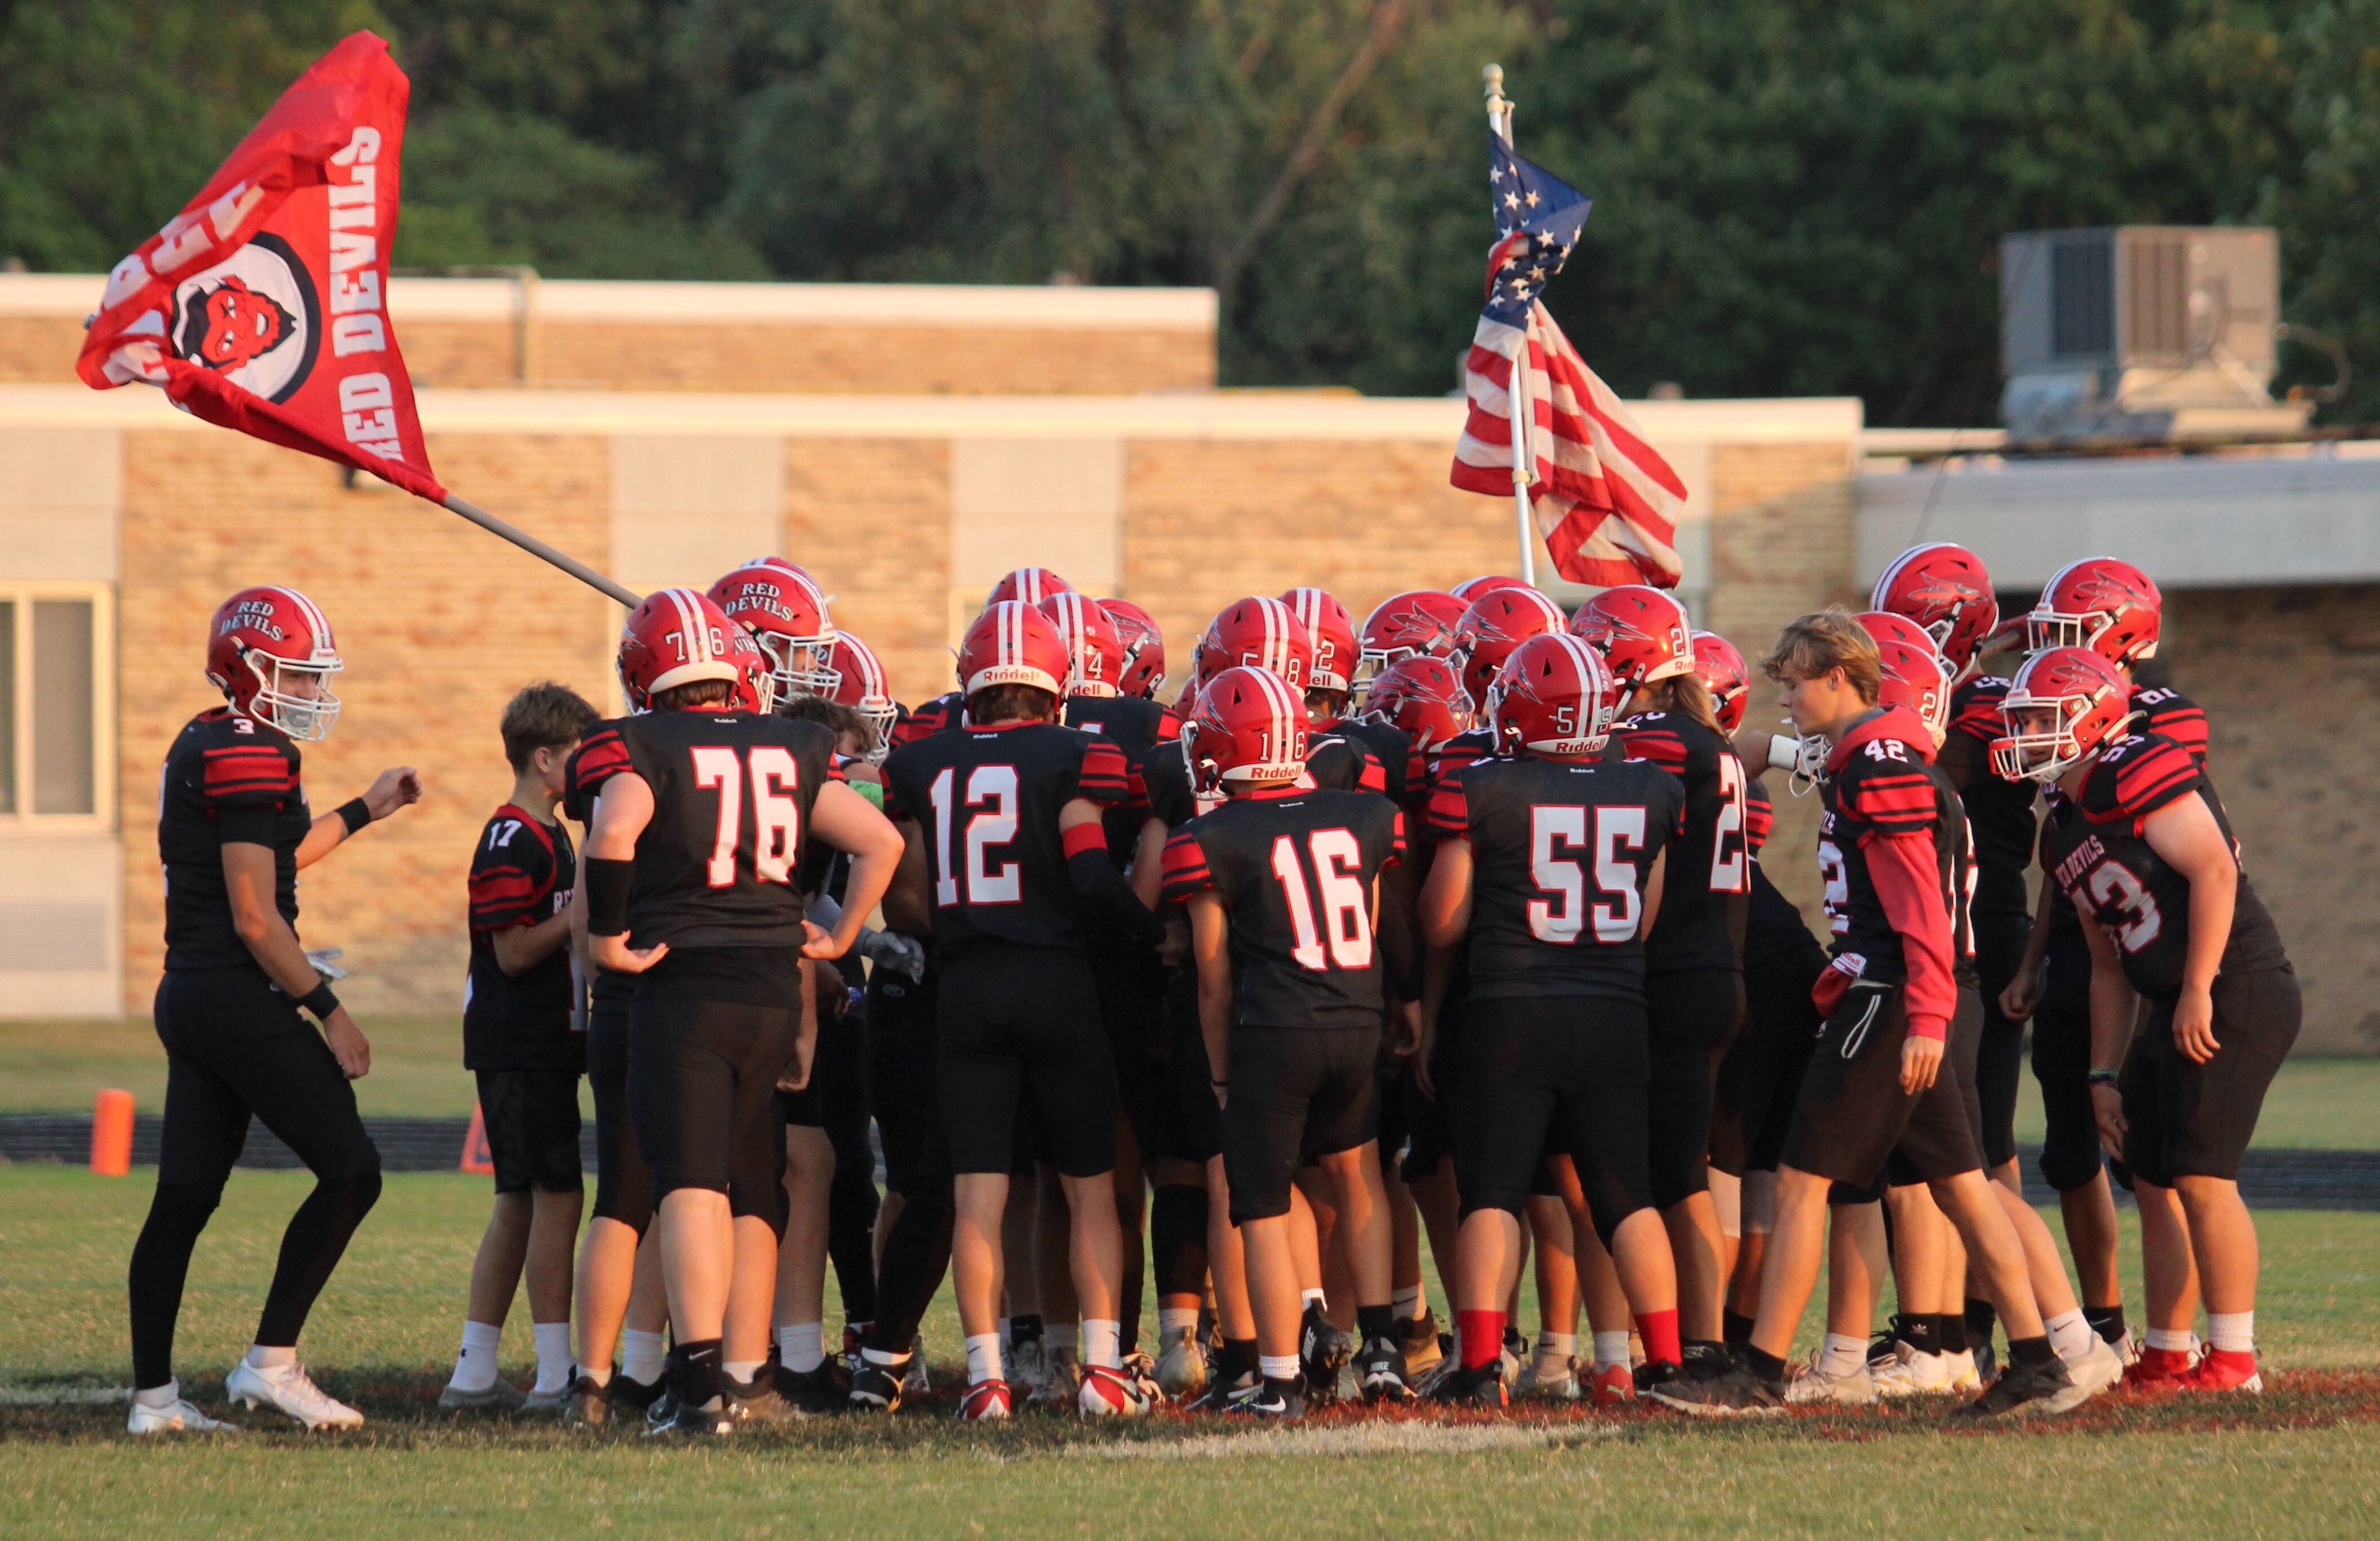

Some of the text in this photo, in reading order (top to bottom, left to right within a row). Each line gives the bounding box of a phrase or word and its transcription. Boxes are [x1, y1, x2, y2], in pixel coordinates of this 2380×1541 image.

[328, 125, 386, 358] DEVILS
[741, 582, 780, 598] RED
[238, 601, 275, 617] RED
[725, 596, 793, 622] DEVILS
[219, 614, 283, 642] DEVILS
[1088, 651, 1103, 680] 4
[1072, 684, 1101, 695] dell
[233, 718, 255, 735] 3
[1556, 739, 1606, 753] Riddell
[1864, 738, 1908, 763] 42
[1250, 765, 1302, 779] Riddell
[690, 746, 798, 888] 76
[1710, 753, 1751, 894] 2
[488, 819, 522, 851] 17
[929, 764, 1023, 909] 12
[1526, 805, 1647, 945] 55
[553, 888, 575, 914] RE
[1271, 826, 1372, 972] 16
